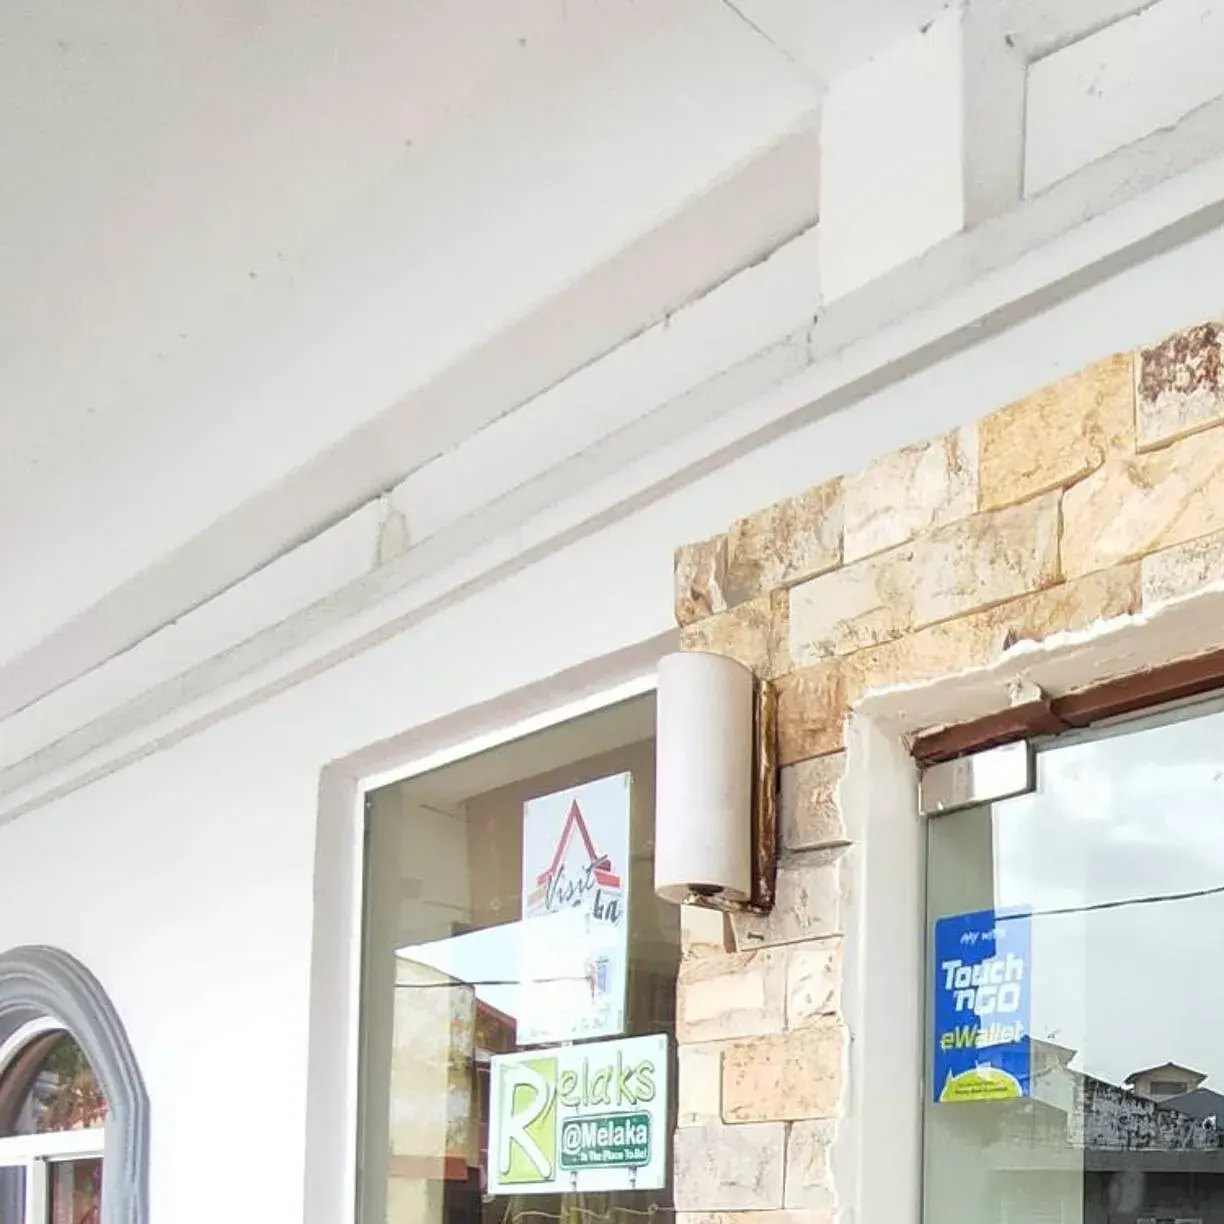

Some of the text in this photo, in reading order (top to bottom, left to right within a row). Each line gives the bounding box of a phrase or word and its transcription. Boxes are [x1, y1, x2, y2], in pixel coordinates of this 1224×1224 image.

[544, 854, 609, 911] Visit
[941, 952, 1024, 991] Touch
[940, 1020, 1023, 1050] eWallet
[562, 1117, 648, 1156] @Melaka
